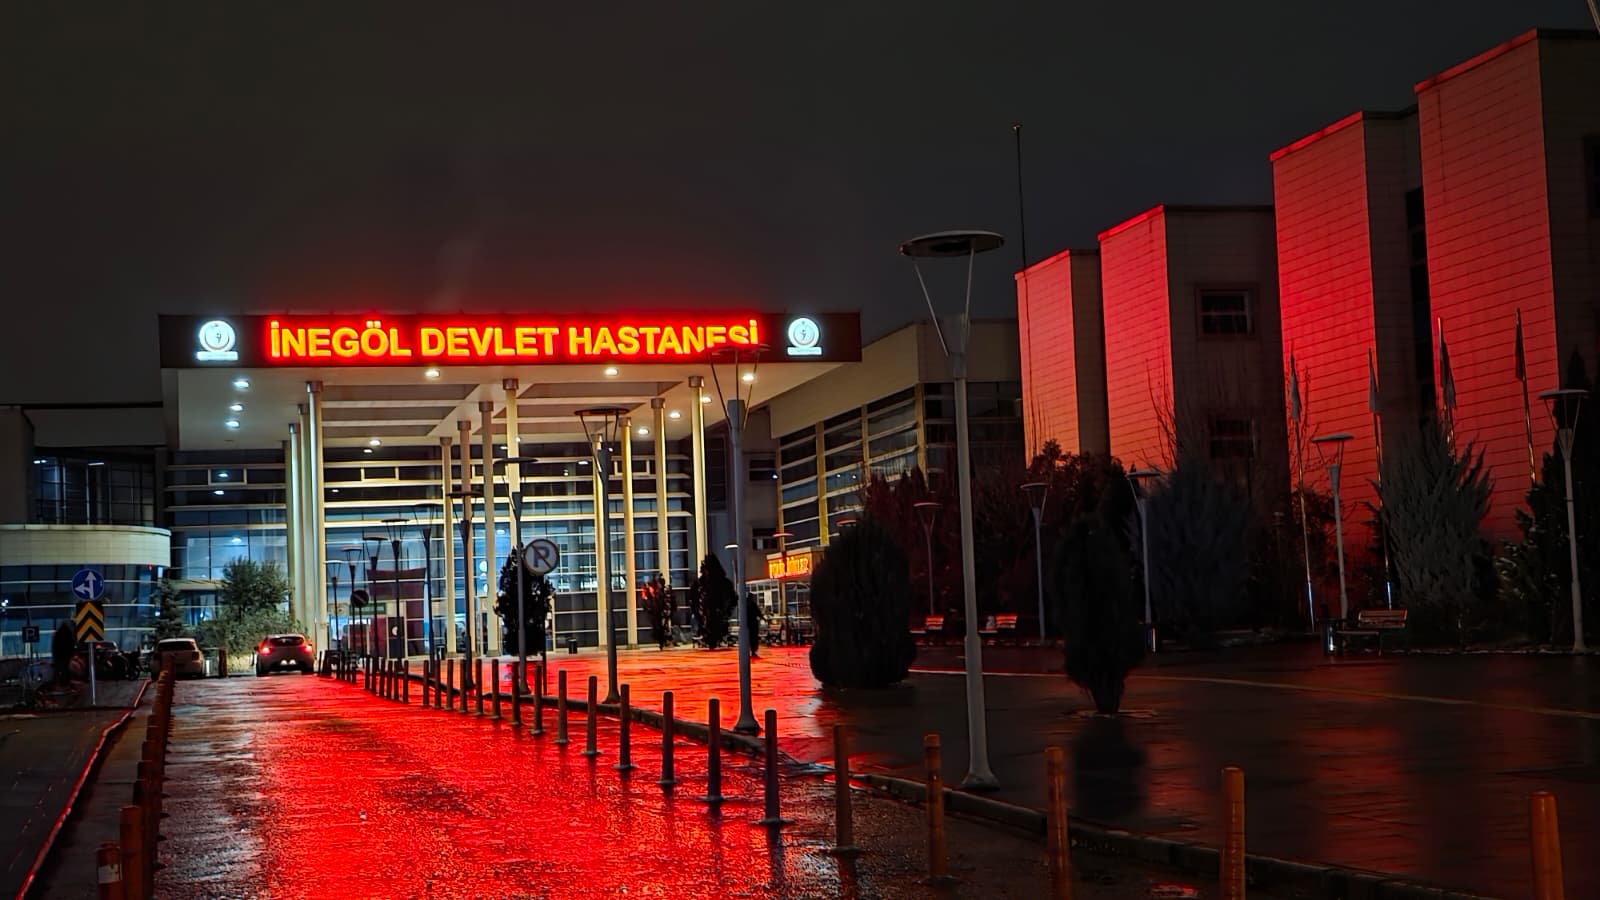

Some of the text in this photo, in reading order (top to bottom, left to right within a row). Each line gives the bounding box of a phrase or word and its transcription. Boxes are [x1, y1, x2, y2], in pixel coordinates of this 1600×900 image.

[270, 320, 412, 357] İNEGÖL
[420, 327, 559, 357] DEVLET
[534, 546, 550, 568] P
